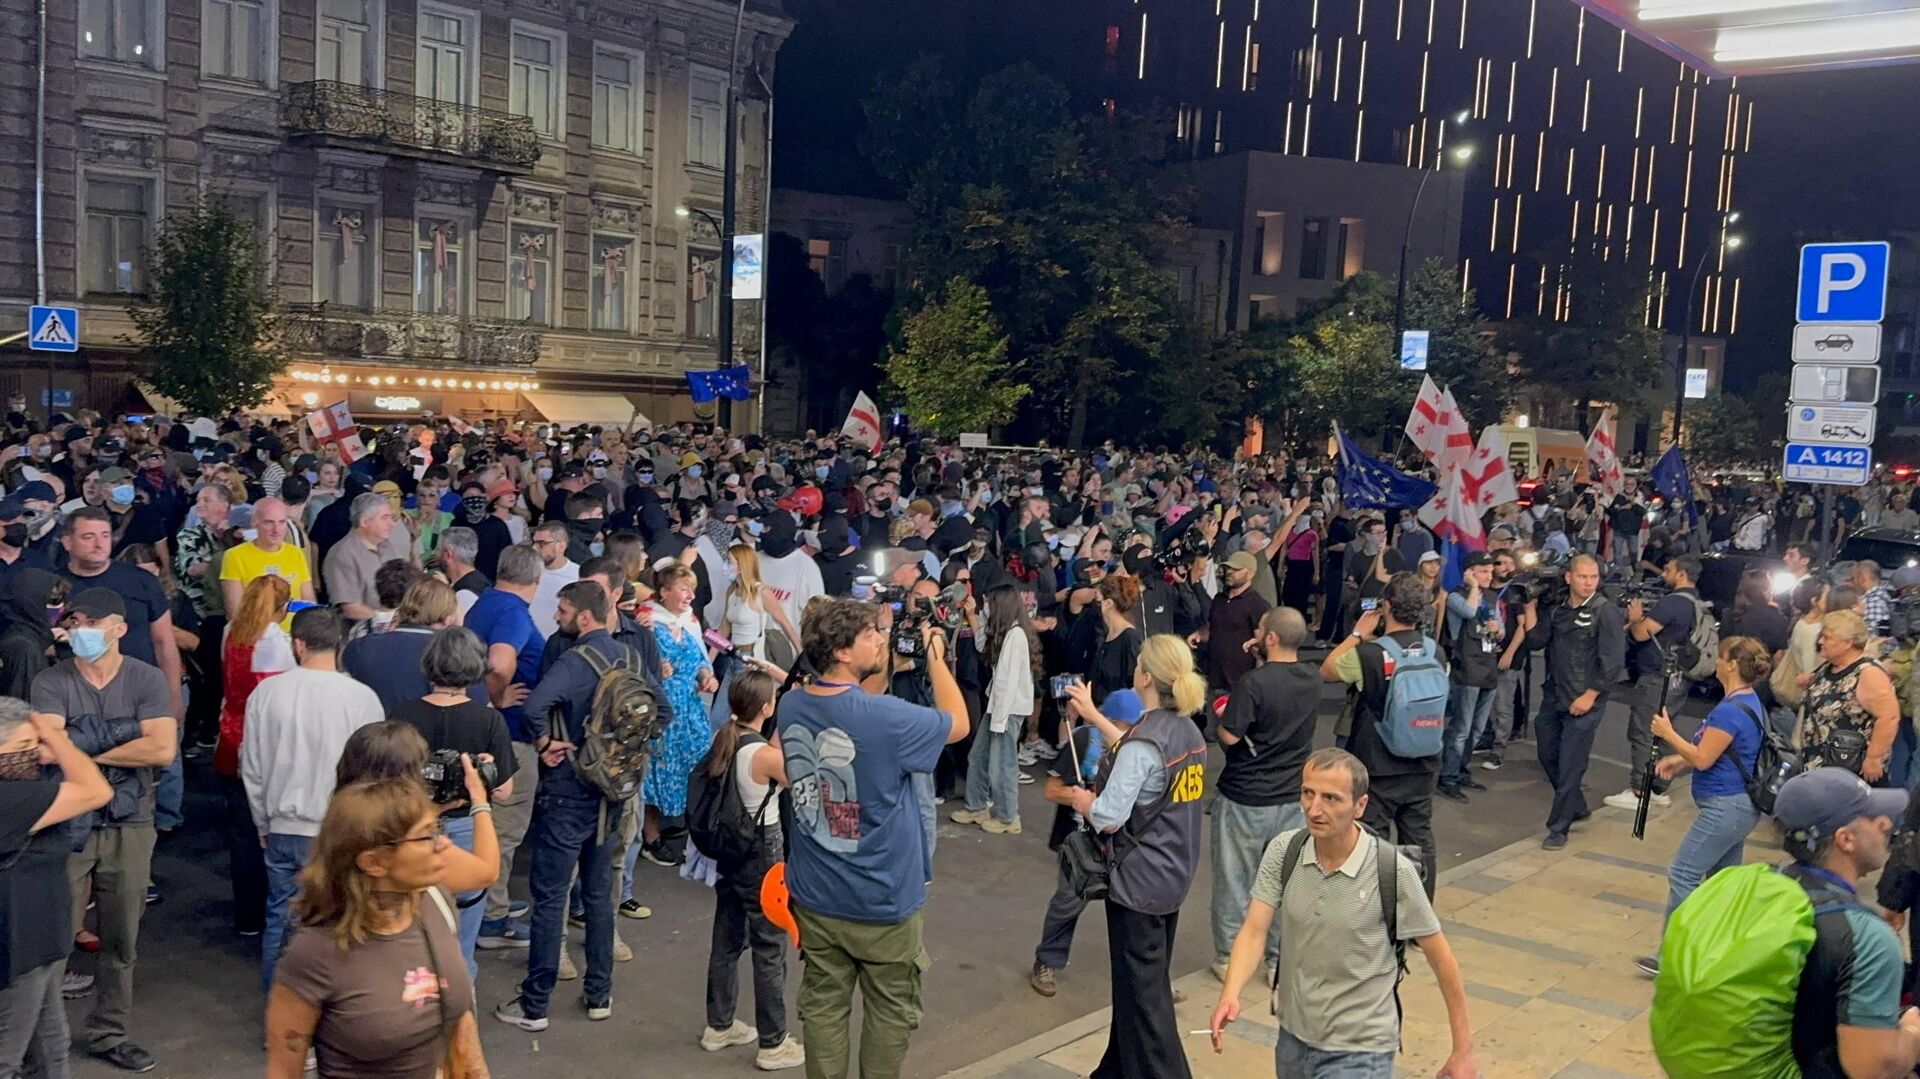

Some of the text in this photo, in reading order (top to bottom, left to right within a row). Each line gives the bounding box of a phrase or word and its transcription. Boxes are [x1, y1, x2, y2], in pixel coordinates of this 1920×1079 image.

[1817, 253, 1867, 314] P
[1798, 447, 1865, 465] A 1412
